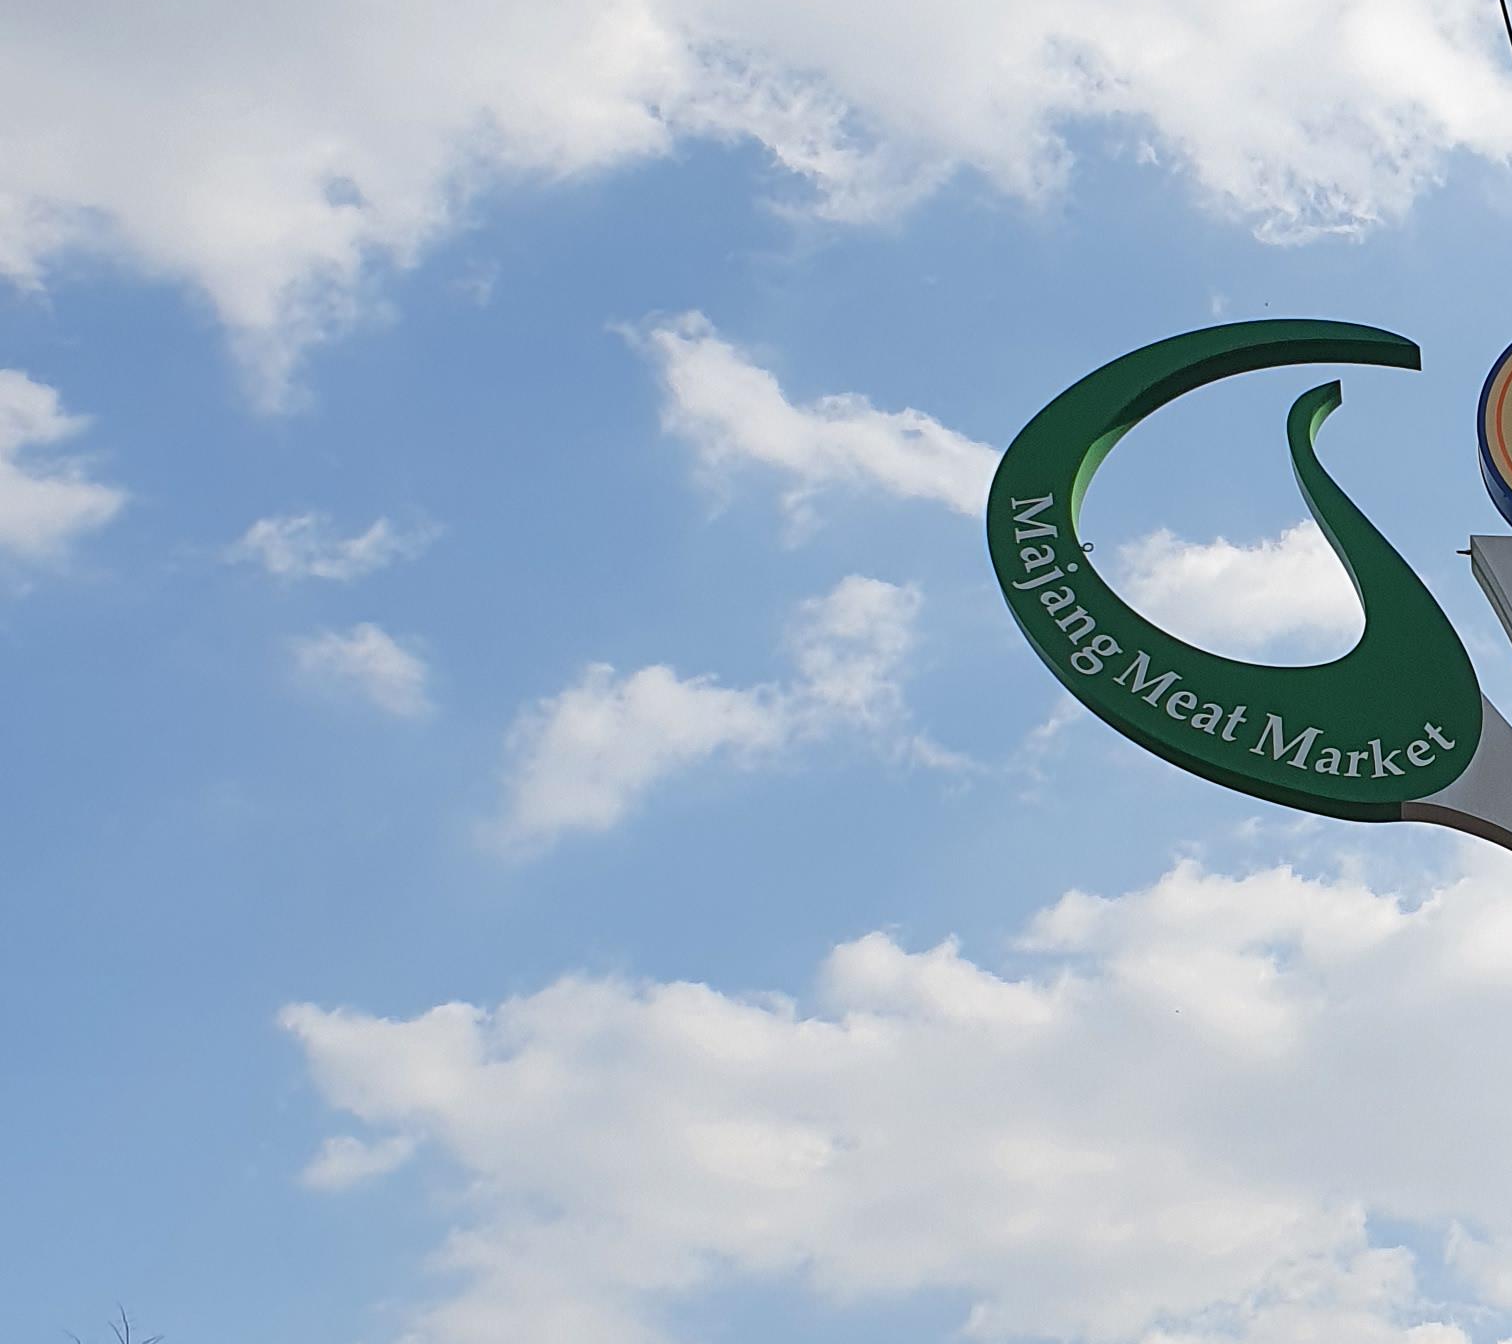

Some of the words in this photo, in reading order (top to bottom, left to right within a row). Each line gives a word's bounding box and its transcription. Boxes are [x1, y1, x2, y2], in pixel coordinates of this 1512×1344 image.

[1010, 492, 1124, 676] Majang
[1112, 650, 1248, 742] Meat
[1249, 713, 1457, 779] Market
